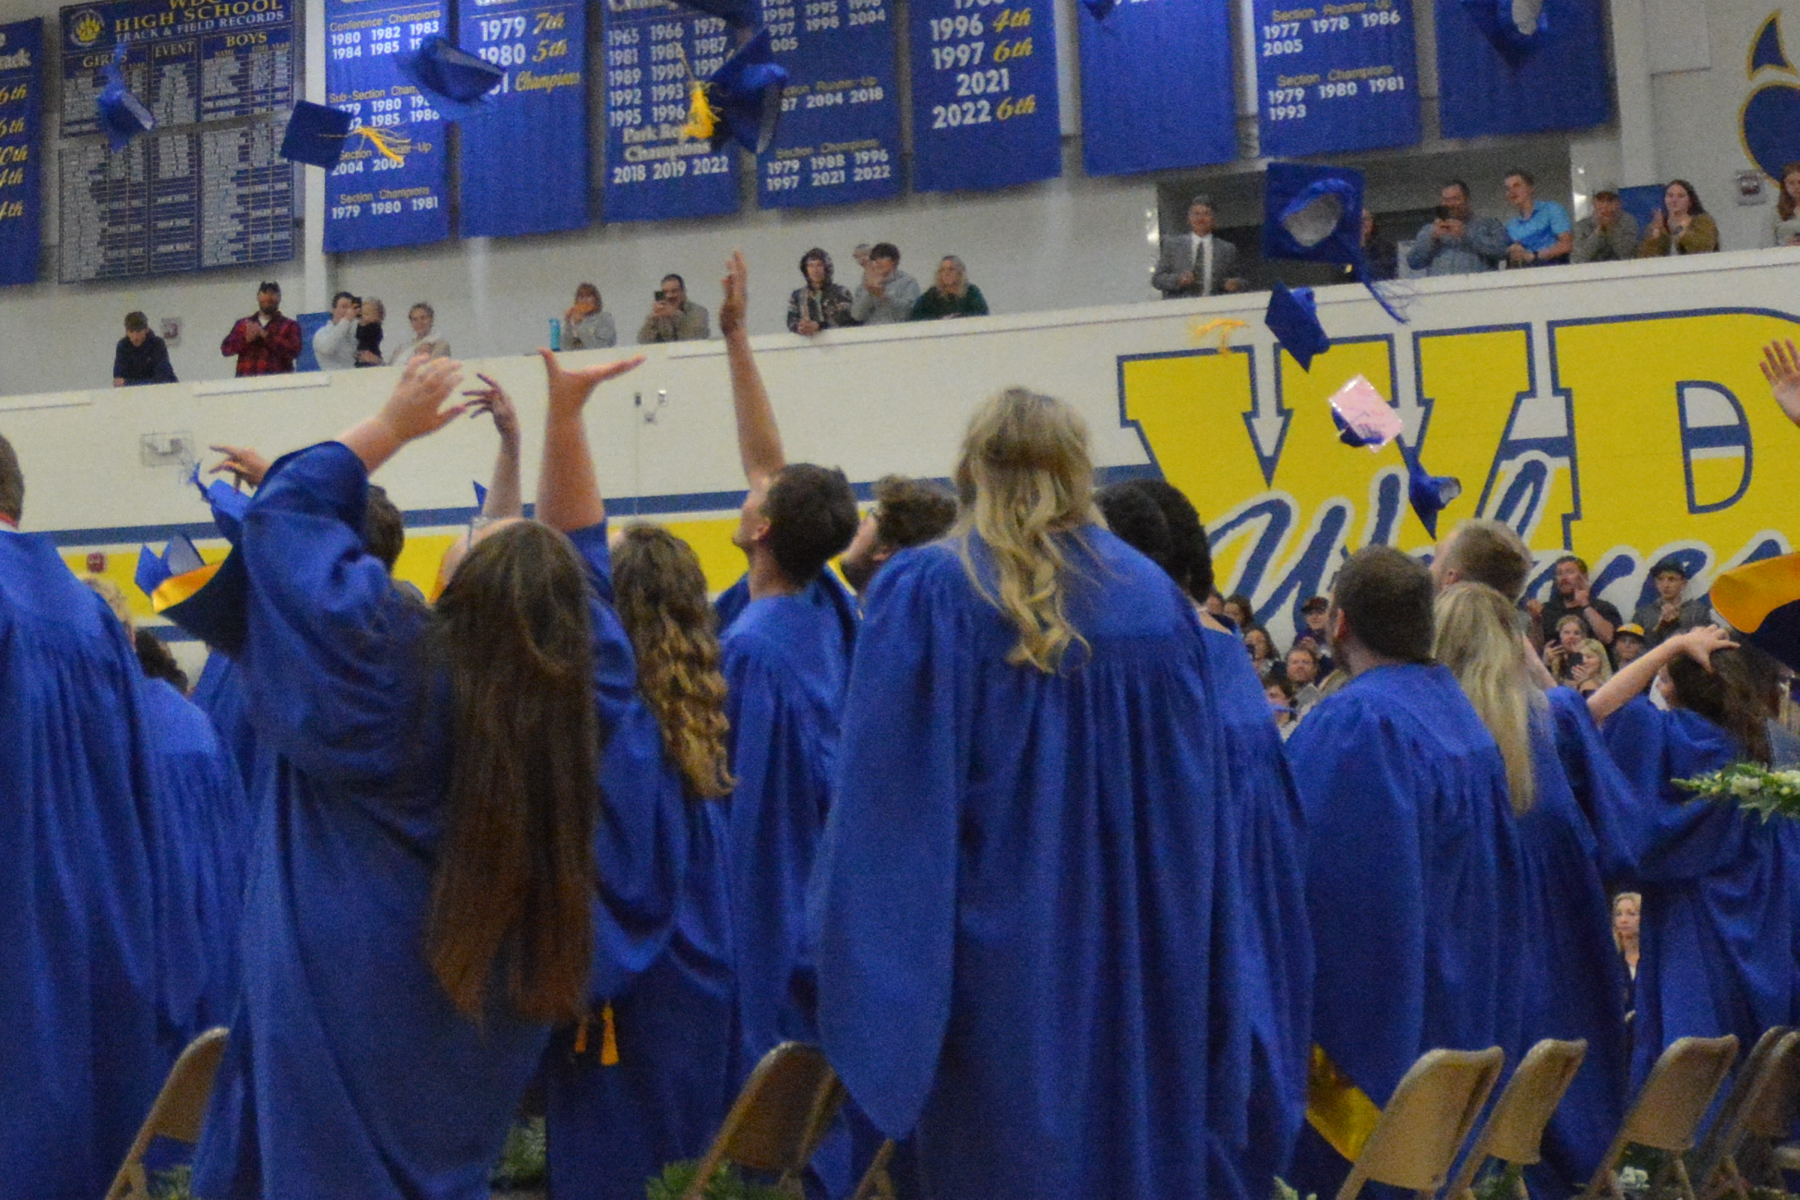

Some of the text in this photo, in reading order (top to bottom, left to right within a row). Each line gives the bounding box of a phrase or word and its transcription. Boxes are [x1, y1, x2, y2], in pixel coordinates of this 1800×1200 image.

[115, 11, 175, 33] HIGH
[116, 10, 285, 44] TRACK & FIELD RECORDS
[389, 10, 441, 24] Champions
[481, 12, 565, 41] 1979 7th
[849, 8, 886, 26] 2004
[930, 7, 1032, 42] 1996 4th
[1263, 10, 1401, 40] 1977 1978 1986
[226, 31, 268, 48] BOYS
[331, 21, 439, 46] 1980 1982 1983
[609, 28, 639, 46] 1965
[651, 23, 684, 41] 1966
[154, 42, 195, 58] EVENT
[332, 46, 362, 60] 1984
[371, 41, 400, 55] 1985
[478, 39, 567, 66] 1980 5th
[609, 36, 727, 66] 1981 1987
[932, 37, 1033, 70] 1997 6th
[1263, 39, 1303, 57] 2005
[609, 62, 684, 86] 1989 1990
[957, 68, 1010, 97] 2021
[609, 83, 684, 106] 1992 1993
[806, 86, 884, 109] 2004 2018
[1268, 76, 1404, 105] 1979 1980 1981
[371, 98, 402, 112] 1980
[609, 104, 685, 126] 1995 1996
[932, 94, 1036, 129] 2022 6th
[1269, 104, 1307, 121] 1993
[371, 109, 440, 127] 1985 1986
[613, 156, 729, 184] 2018 2019 2022
[767, 148, 889, 175] 1979 1988 1996
[766, 165, 891, 192] 1997 2021 2022
[332, 196, 439, 219] 1979 1980 1981
